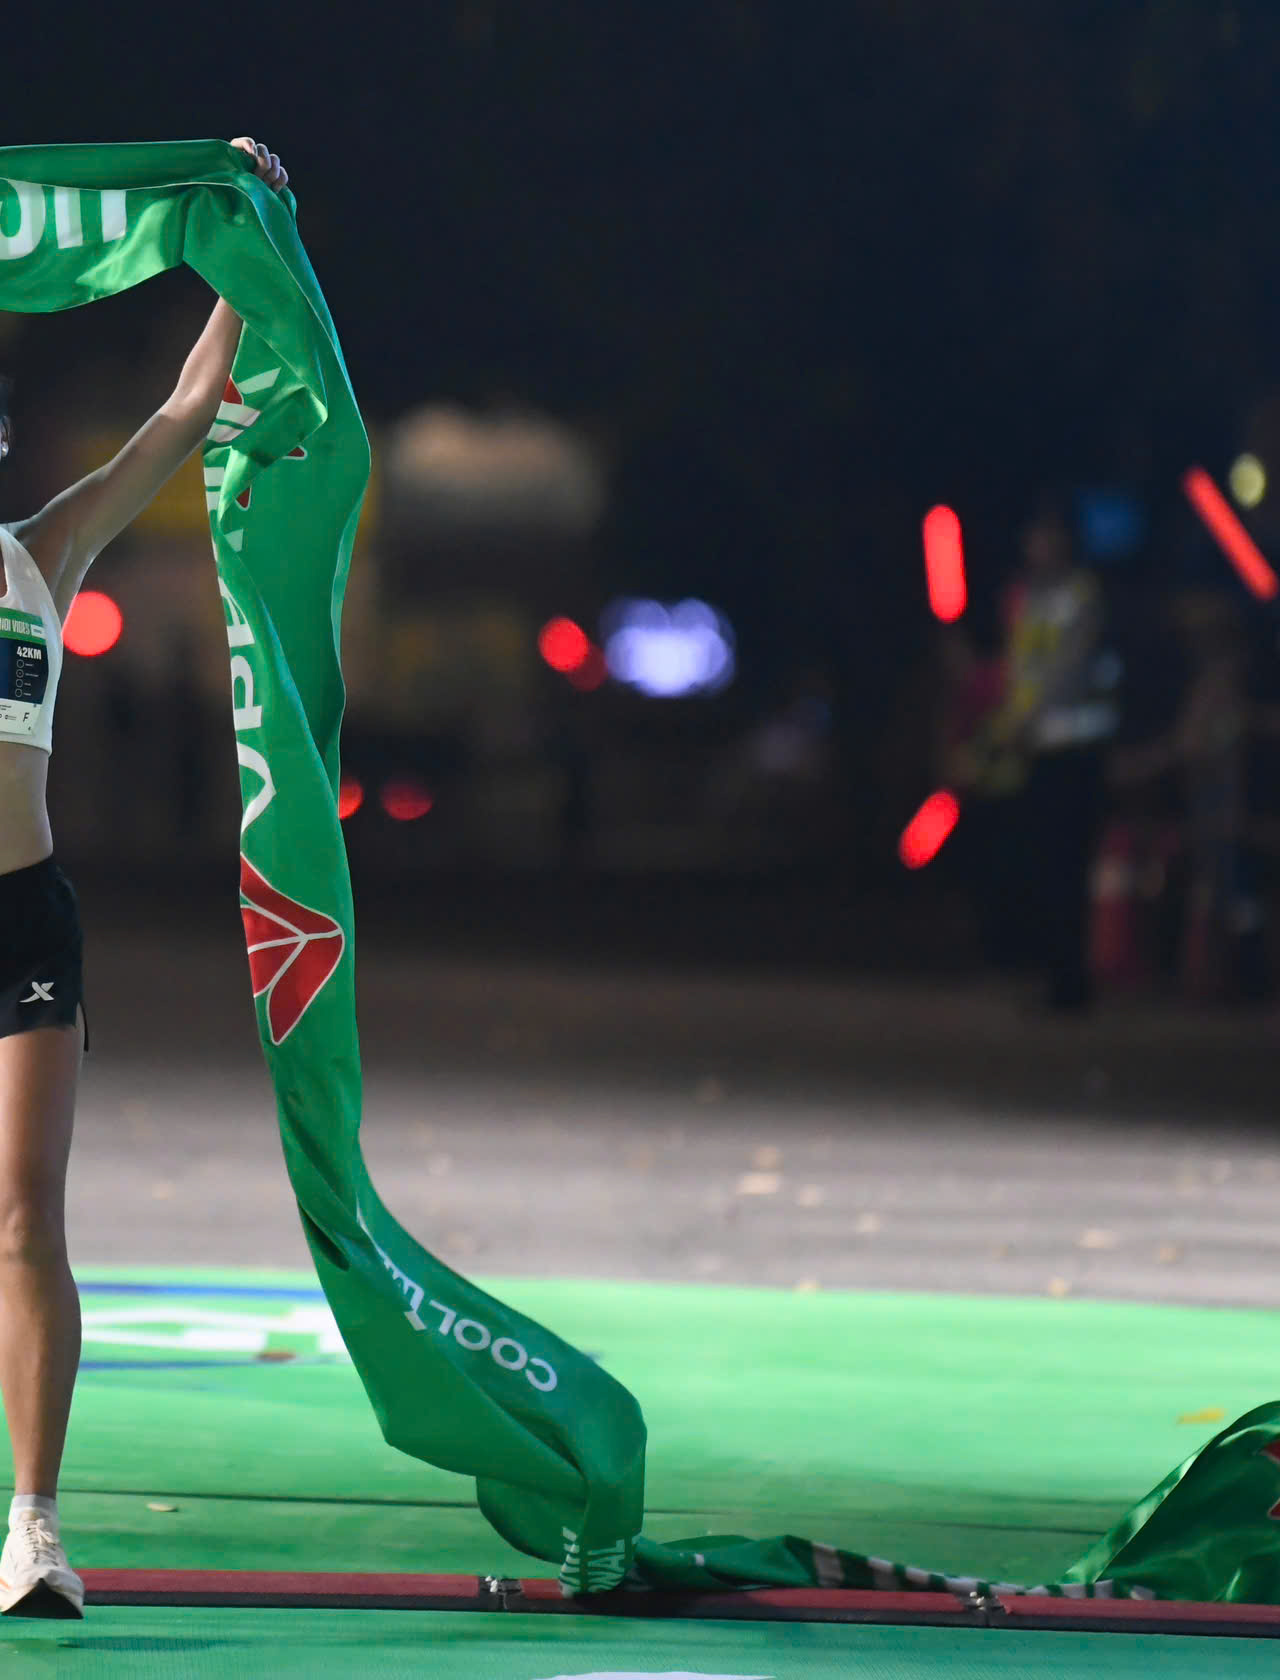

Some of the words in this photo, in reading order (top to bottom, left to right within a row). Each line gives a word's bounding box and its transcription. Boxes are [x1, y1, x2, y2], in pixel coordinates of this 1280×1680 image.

[16, 646, 42, 660] 42KM
[22, 712, 30, 722] F
[429, 1299, 558, 1393] COOL
